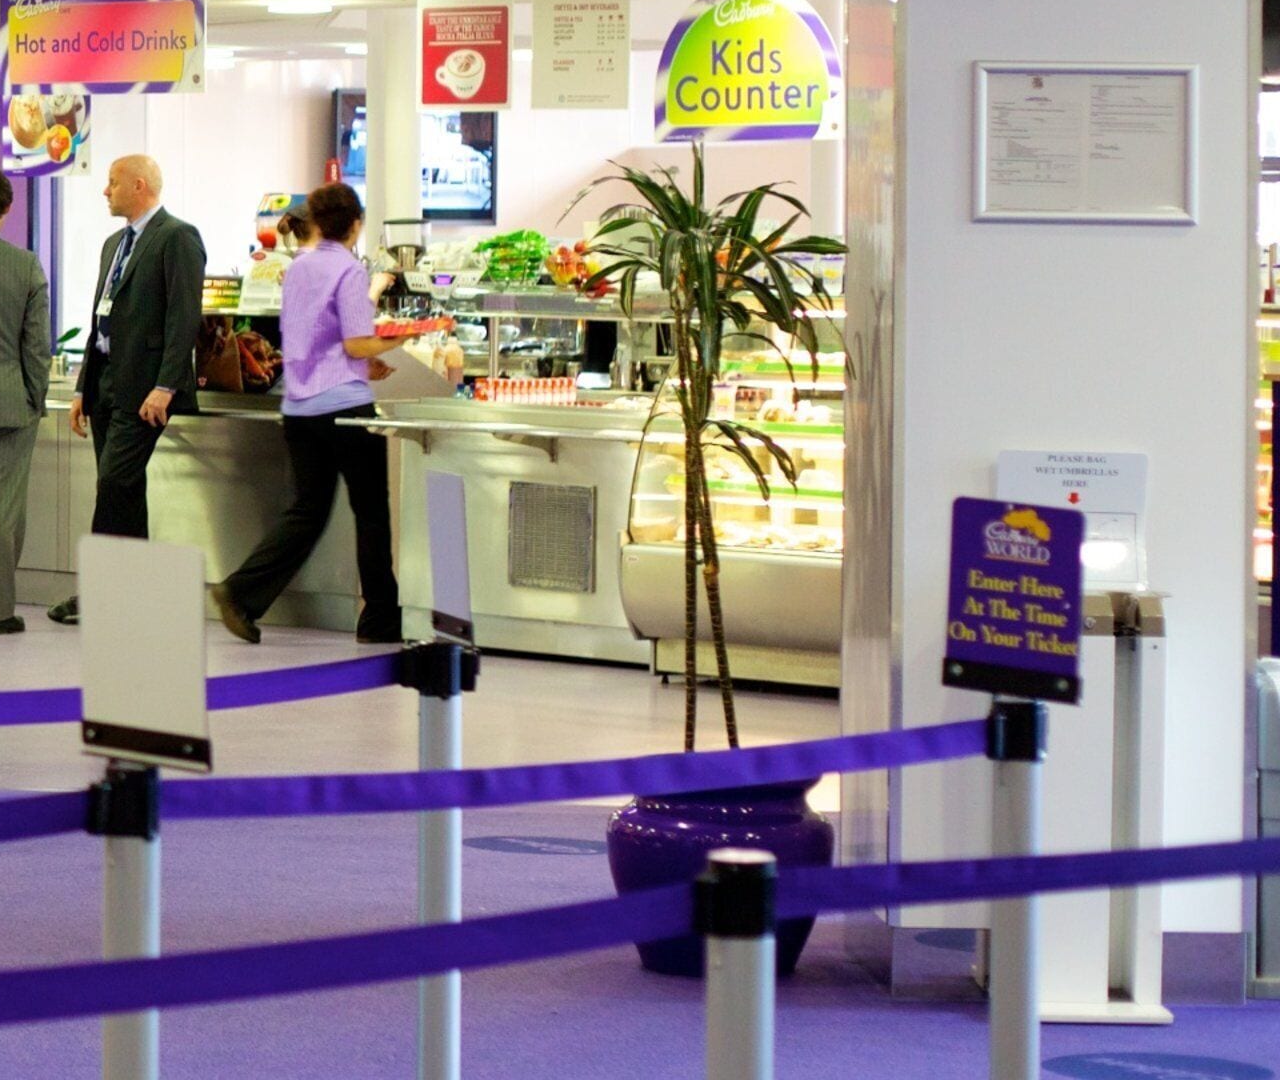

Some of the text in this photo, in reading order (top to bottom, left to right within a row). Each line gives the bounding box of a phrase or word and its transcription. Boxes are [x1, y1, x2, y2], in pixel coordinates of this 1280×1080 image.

[15, 29, 188, 54] Hot and Cold Drinks
[710, 38, 783, 76] Kids
[674, 75, 820, 112] Counter
[1035, 466, 1120, 477] WET UMBRELLAS
[1048, 455, 1107, 464] PLEASE BAG
[986, 539, 1051, 562] WORLD
[968, 569, 1065, 600] Enter Here
[963, 596, 1069, 628] At The Time
[949, 621, 1079, 657] On Your Ticket
